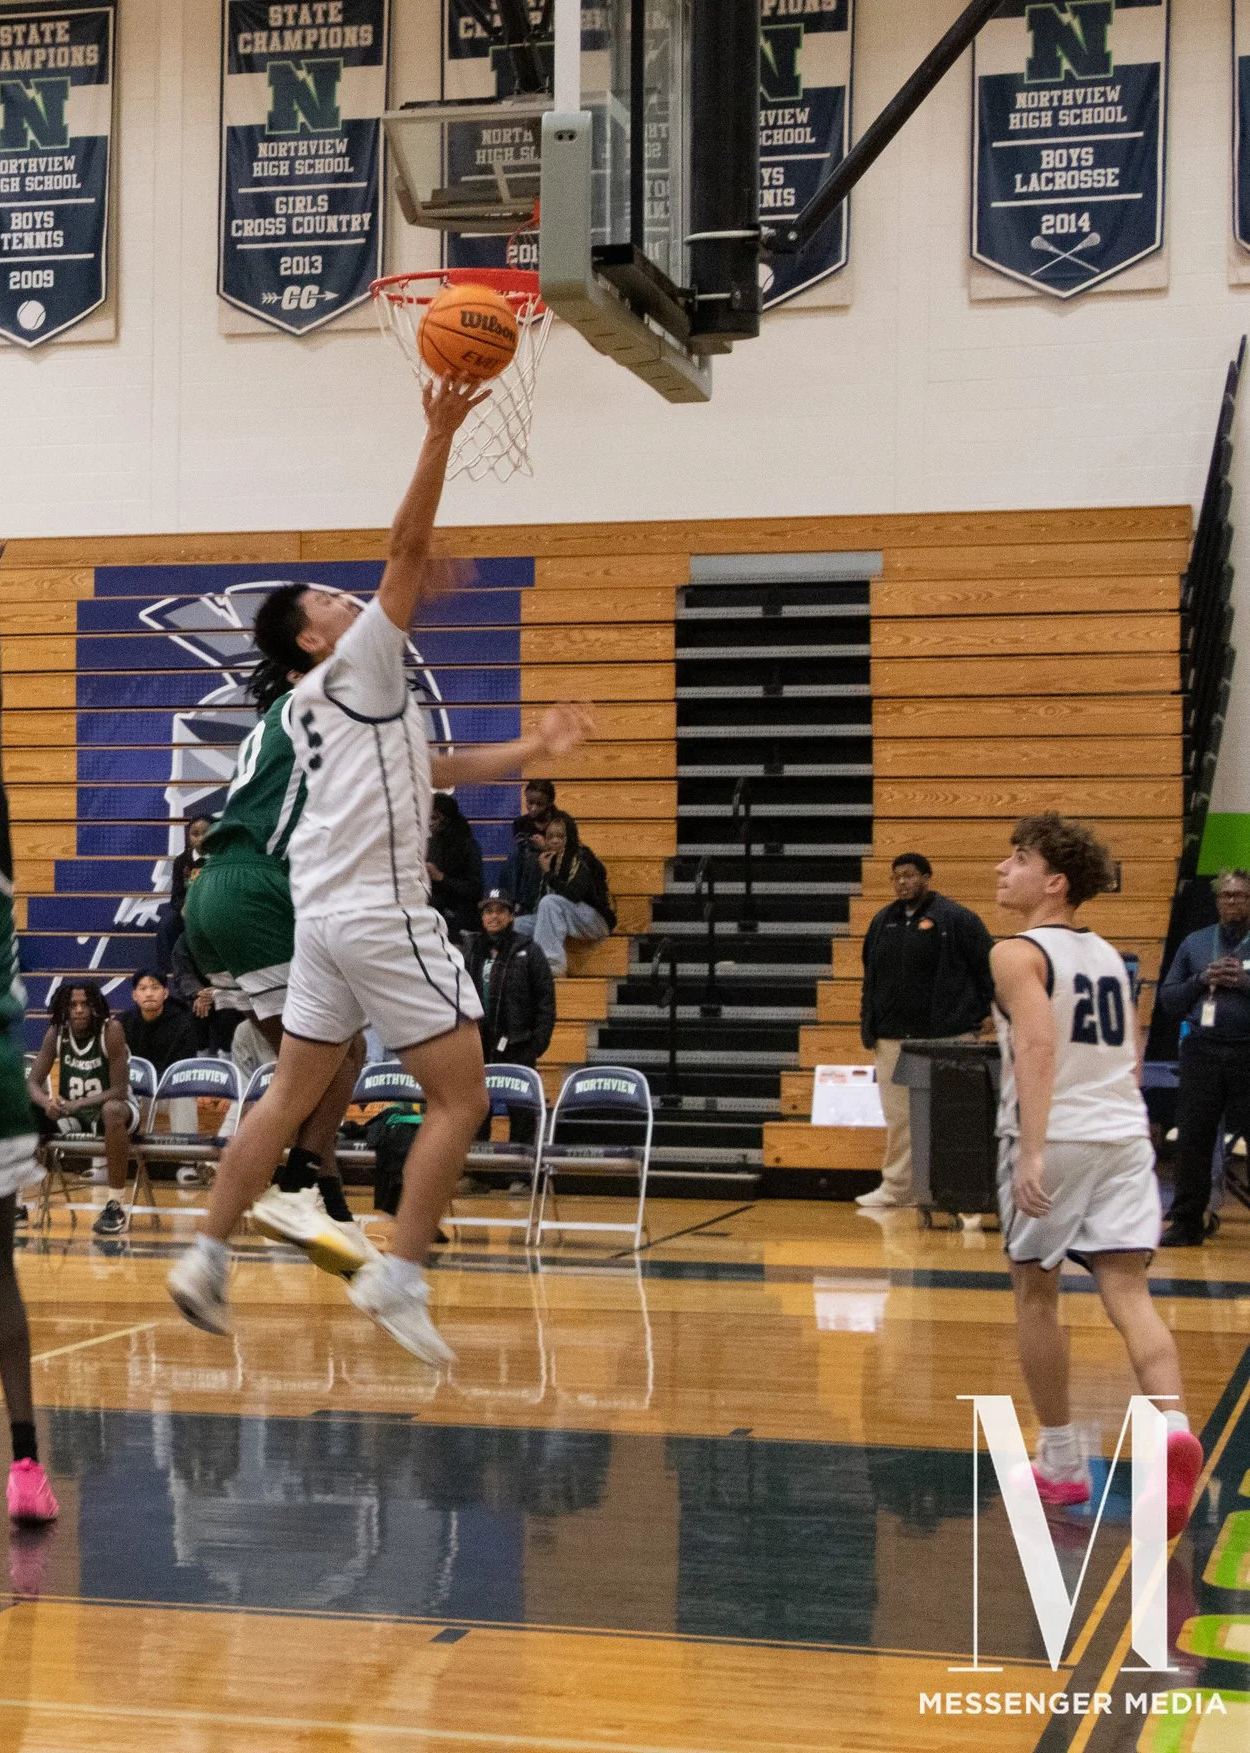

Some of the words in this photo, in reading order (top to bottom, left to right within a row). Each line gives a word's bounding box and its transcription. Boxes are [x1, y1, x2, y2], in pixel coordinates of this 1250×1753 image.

[268, 1, 343, 27] STATE
[238, 24, 373, 55] CHAMPIONS
[266, 58, 343, 135] N
[1015, 86, 1121, 109] NORTHVIEW
[1009, 111, 1053, 131] HIGH
[1058, 106, 1127, 128] SCHOOL
[257, 138, 348, 158] NORTHVIEW
[475, 148, 516, 165] HIGH
[1040, 147, 1094, 170] BOYS
[252, 159, 290, 177] HIGH
[295, 156, 354, 174] SCHOOL
[25, 173, 81, 191] SCHOOL
[1014, 168, 1120, 193] LACROSSE
[275, 194, 328, 215] GIRLS
[9, 211, 54, 230] BOYS
[231, 217, 286, 238] CROSS
[291, 212, 372, 235] COUNTRY
[1041, 213, 1091, 235] 2014
[0, 230, 64, 251] TENNIS
[279, 255, 322, 276] 2013
[9, 269, 54, 290] 2009
[460, 310, 516, 343] Wilson
[1070, 973, 1126, 1048] 20
[172, 1069, 229, 1085] NORTHVIEW
[486, 1075, 530, 1094] RTHVIEW
[575, 1077, 637, 1095] NORTHVIEW
